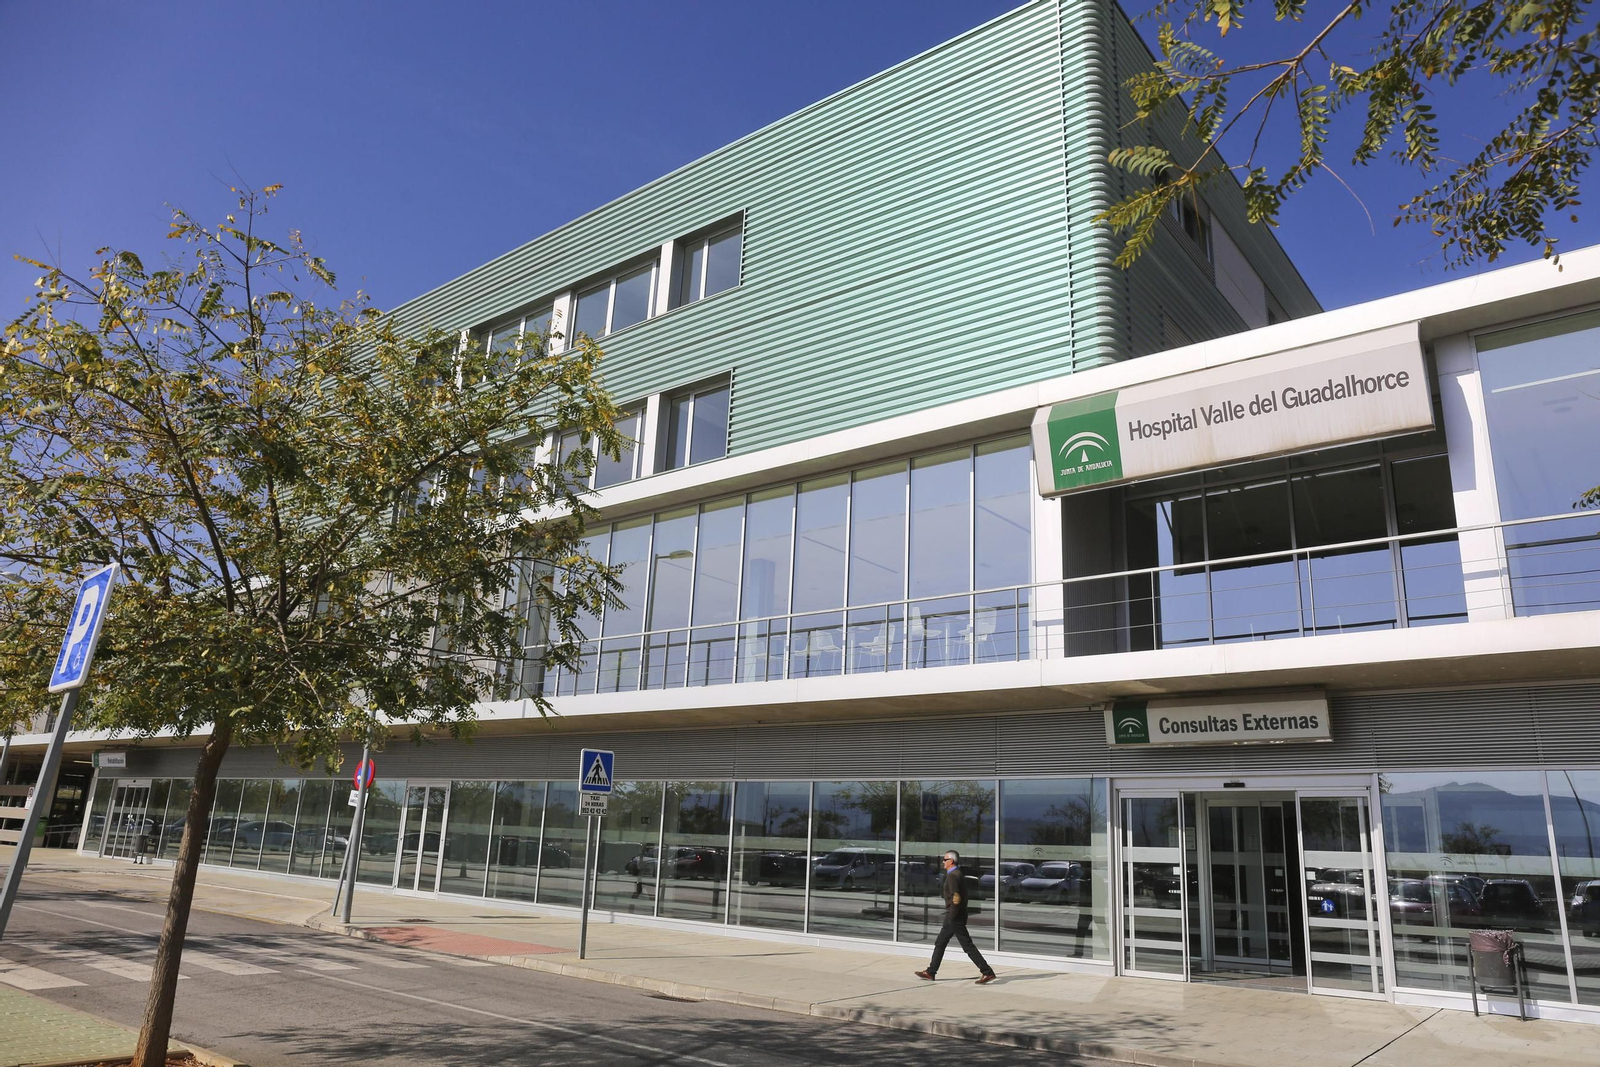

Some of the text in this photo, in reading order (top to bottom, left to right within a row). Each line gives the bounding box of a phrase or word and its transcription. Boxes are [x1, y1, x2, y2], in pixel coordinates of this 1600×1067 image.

[1128, 370, 1410, 441] Hospital Valle del Guadalhorce
[1060, 467, 1076, 476] JUNTA
[1077, 465, 1084, 473] DE
[59, 584, 100, 674] P
[1159, 713, 1319, 734] Consultas Externas
